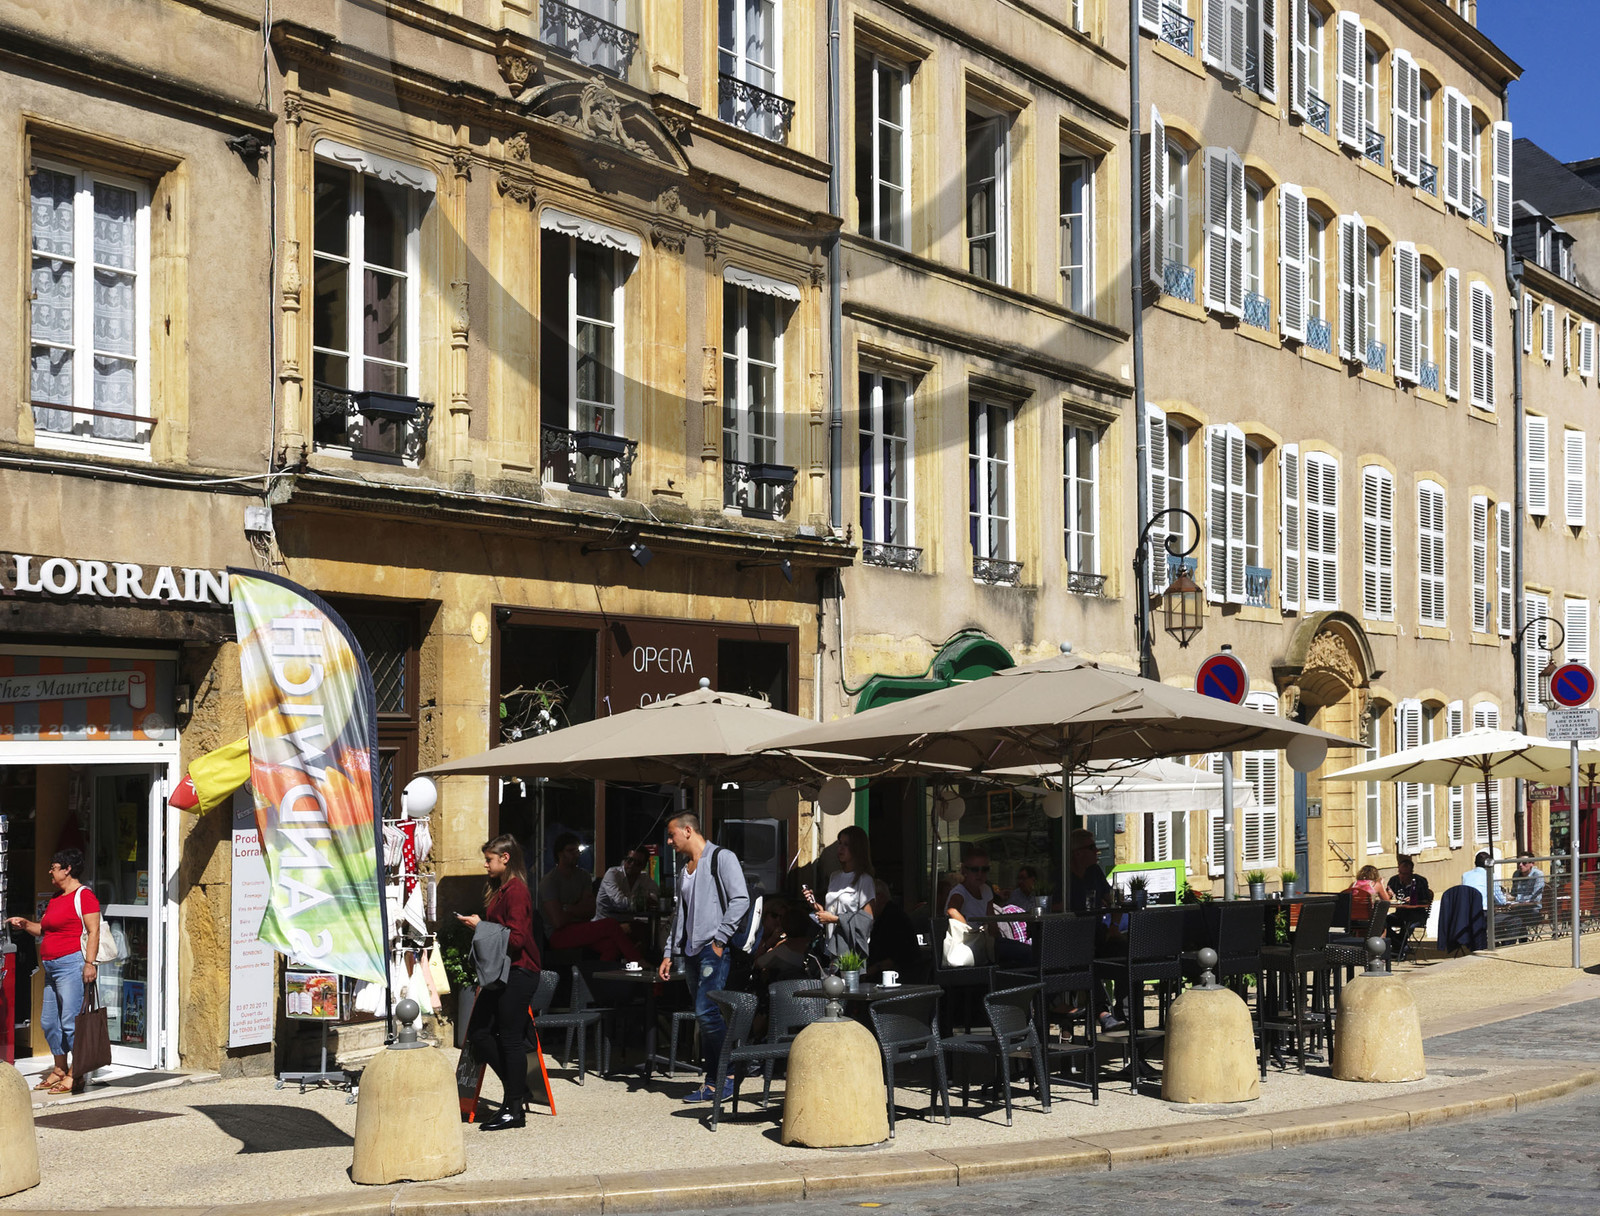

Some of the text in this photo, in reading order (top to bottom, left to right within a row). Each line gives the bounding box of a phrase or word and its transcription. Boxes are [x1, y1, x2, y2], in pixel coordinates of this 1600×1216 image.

[633, 646, 694, 673] OPERA
[0, 676, 126, 699] hez Mauricette
[0, 723, 122, 735] 3 87 20 20 71
